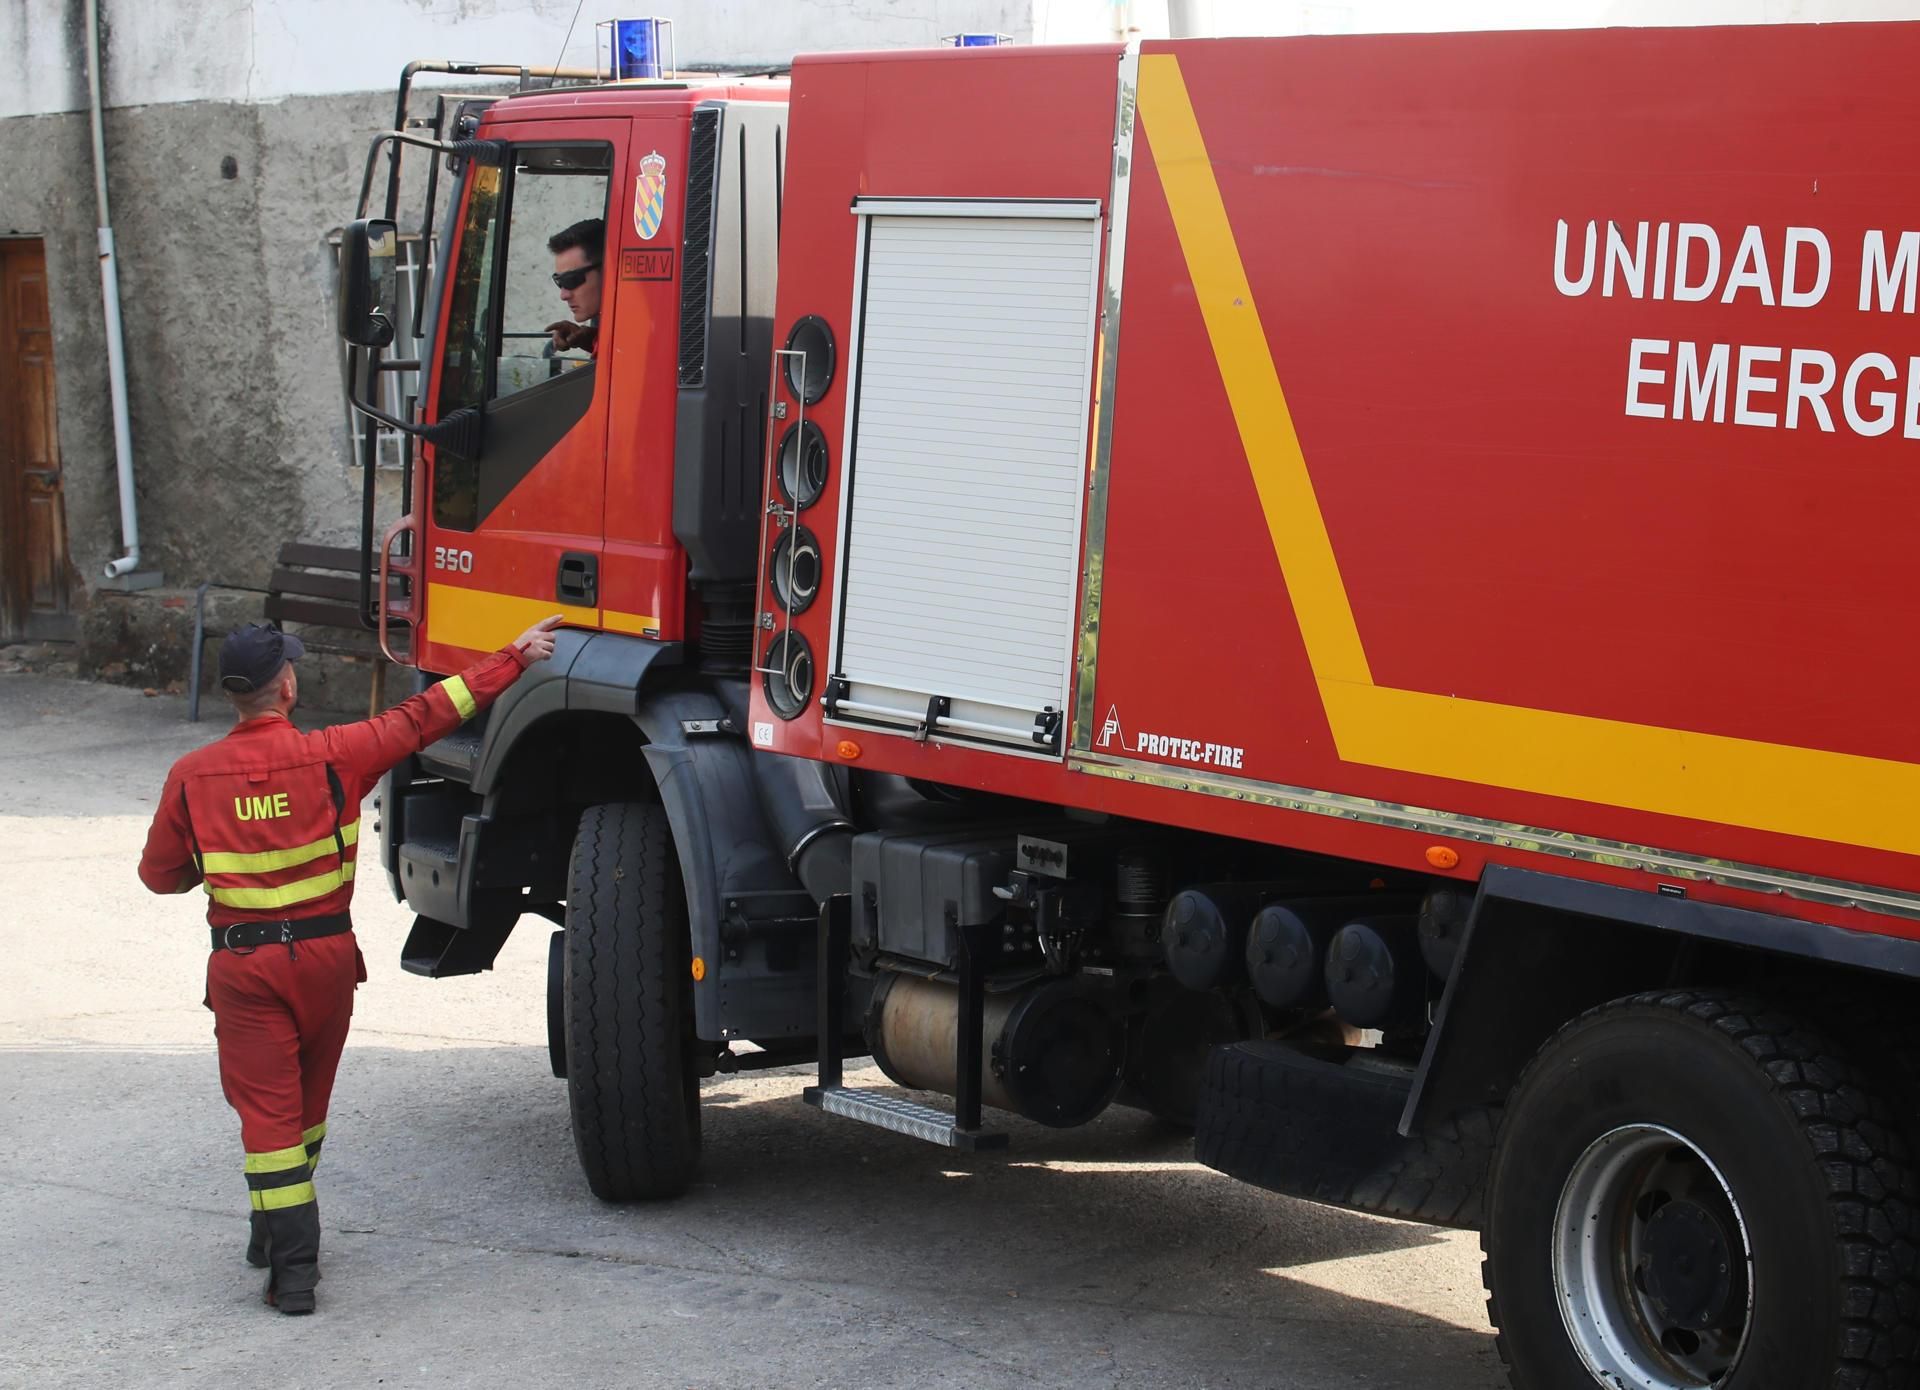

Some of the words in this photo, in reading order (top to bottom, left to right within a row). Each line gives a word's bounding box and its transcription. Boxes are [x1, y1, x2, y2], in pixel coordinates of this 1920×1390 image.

[624, 254, 656, 274] BIEM
[659, 255, 670, 274] V
[1553, 218, 1832, 308] UNIDAD
[434, 546, 473, 574] 350
[234, 792, 291, 821] UME
